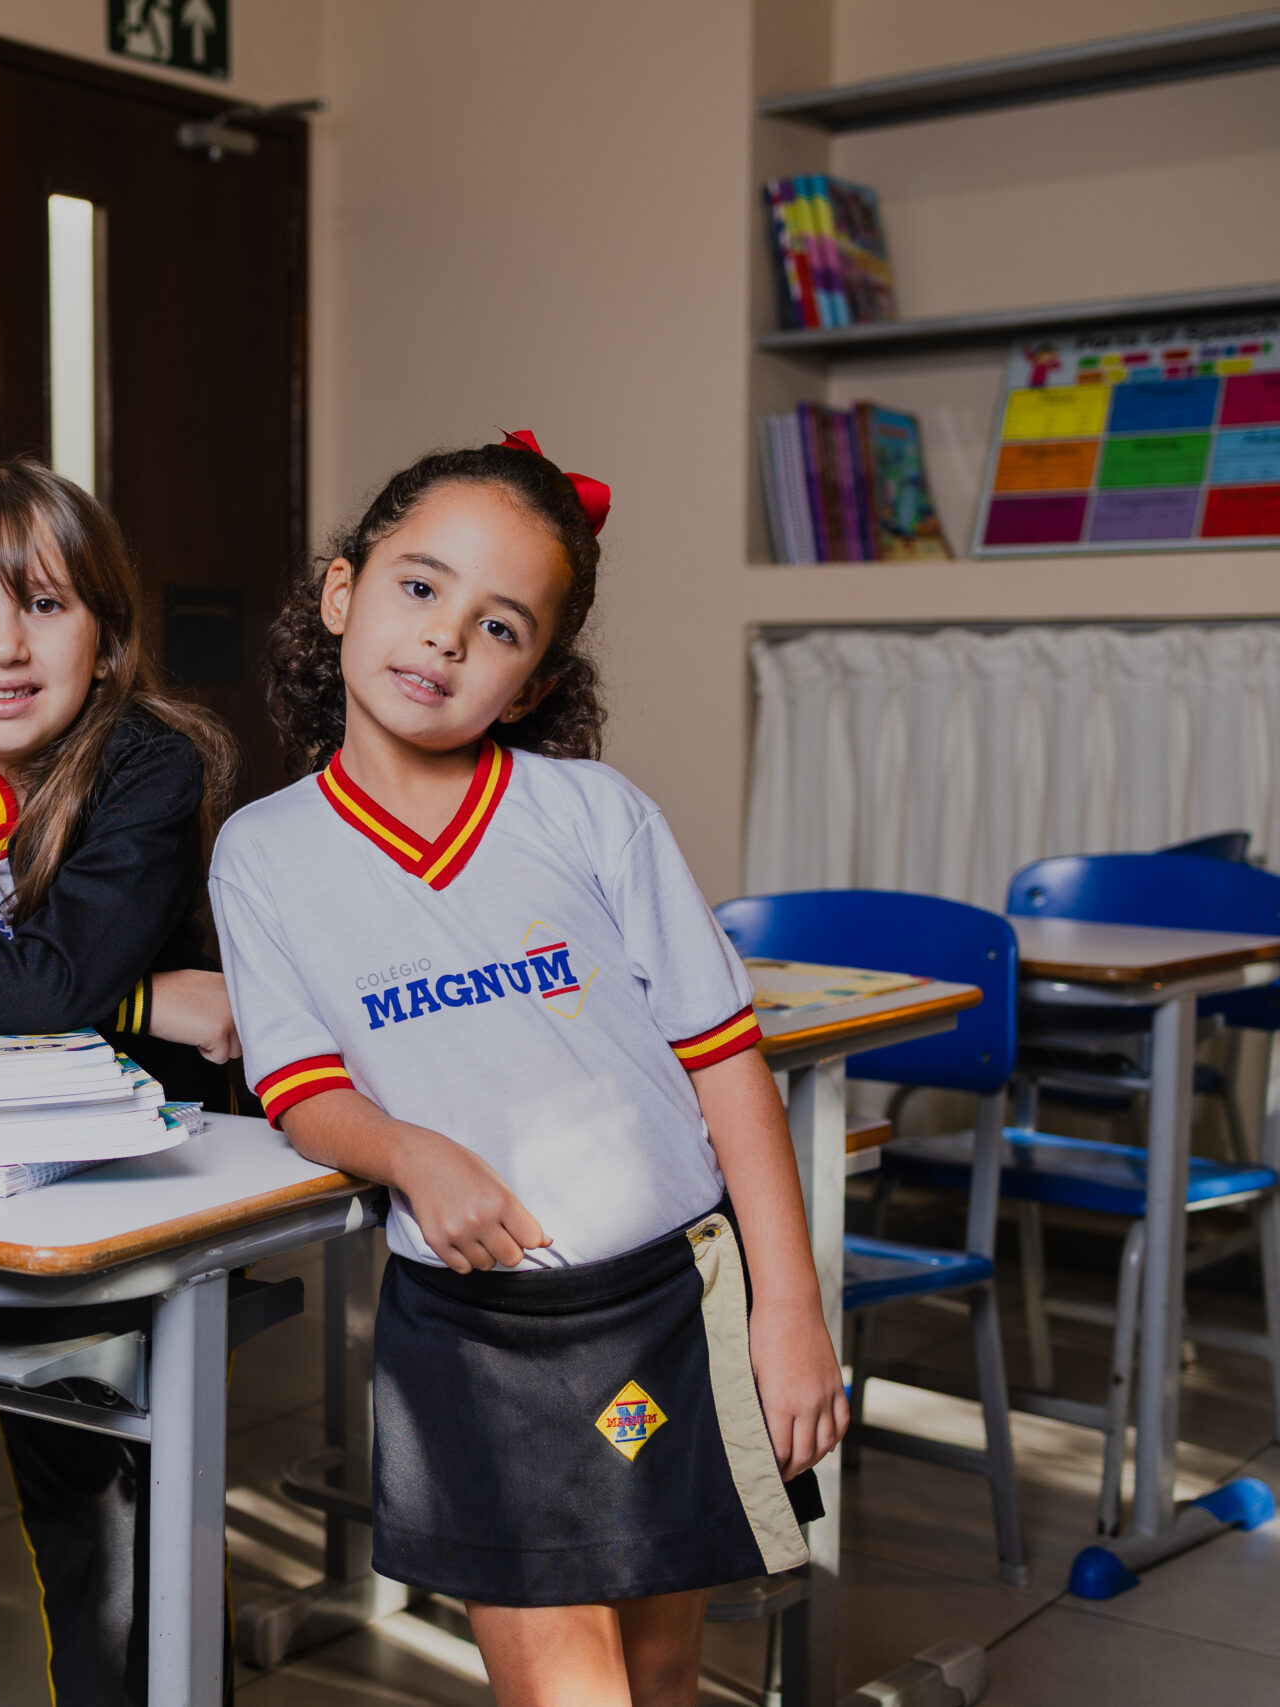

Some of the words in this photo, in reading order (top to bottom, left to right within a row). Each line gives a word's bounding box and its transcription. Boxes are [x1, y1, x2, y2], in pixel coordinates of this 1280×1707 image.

[355, 958, 432, 991] COLÉGIO
[361, 949, 578, 1030] MAGNUM
[606, 1413, 658, 1428] MAGNUM
